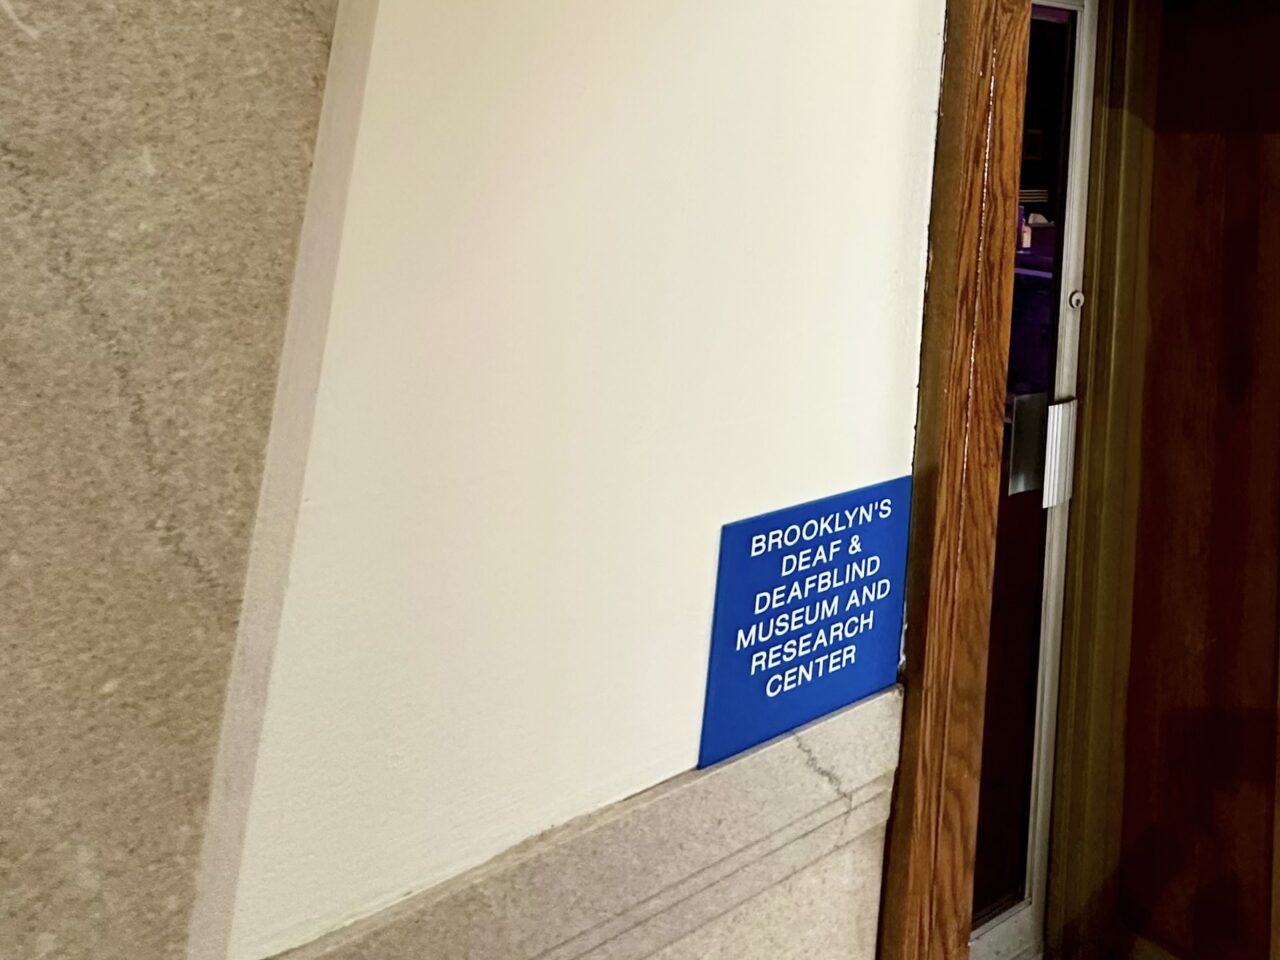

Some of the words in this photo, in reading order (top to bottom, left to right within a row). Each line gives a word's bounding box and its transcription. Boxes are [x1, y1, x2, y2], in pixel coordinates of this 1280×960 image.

[751, 498, 892, 557] BROOKLYN'S
[781, 539, 842, 577] DEAF
[848, 534, 862, 555] &
[754, 555, 881, 615] DEAFBLIND
[736, 596, 839, 651] MUSEUM
[845, 579, 891, 612] AND
[750, 610, 874, 675] RESEARCH
[765, 644, 856, 698] CENTER
